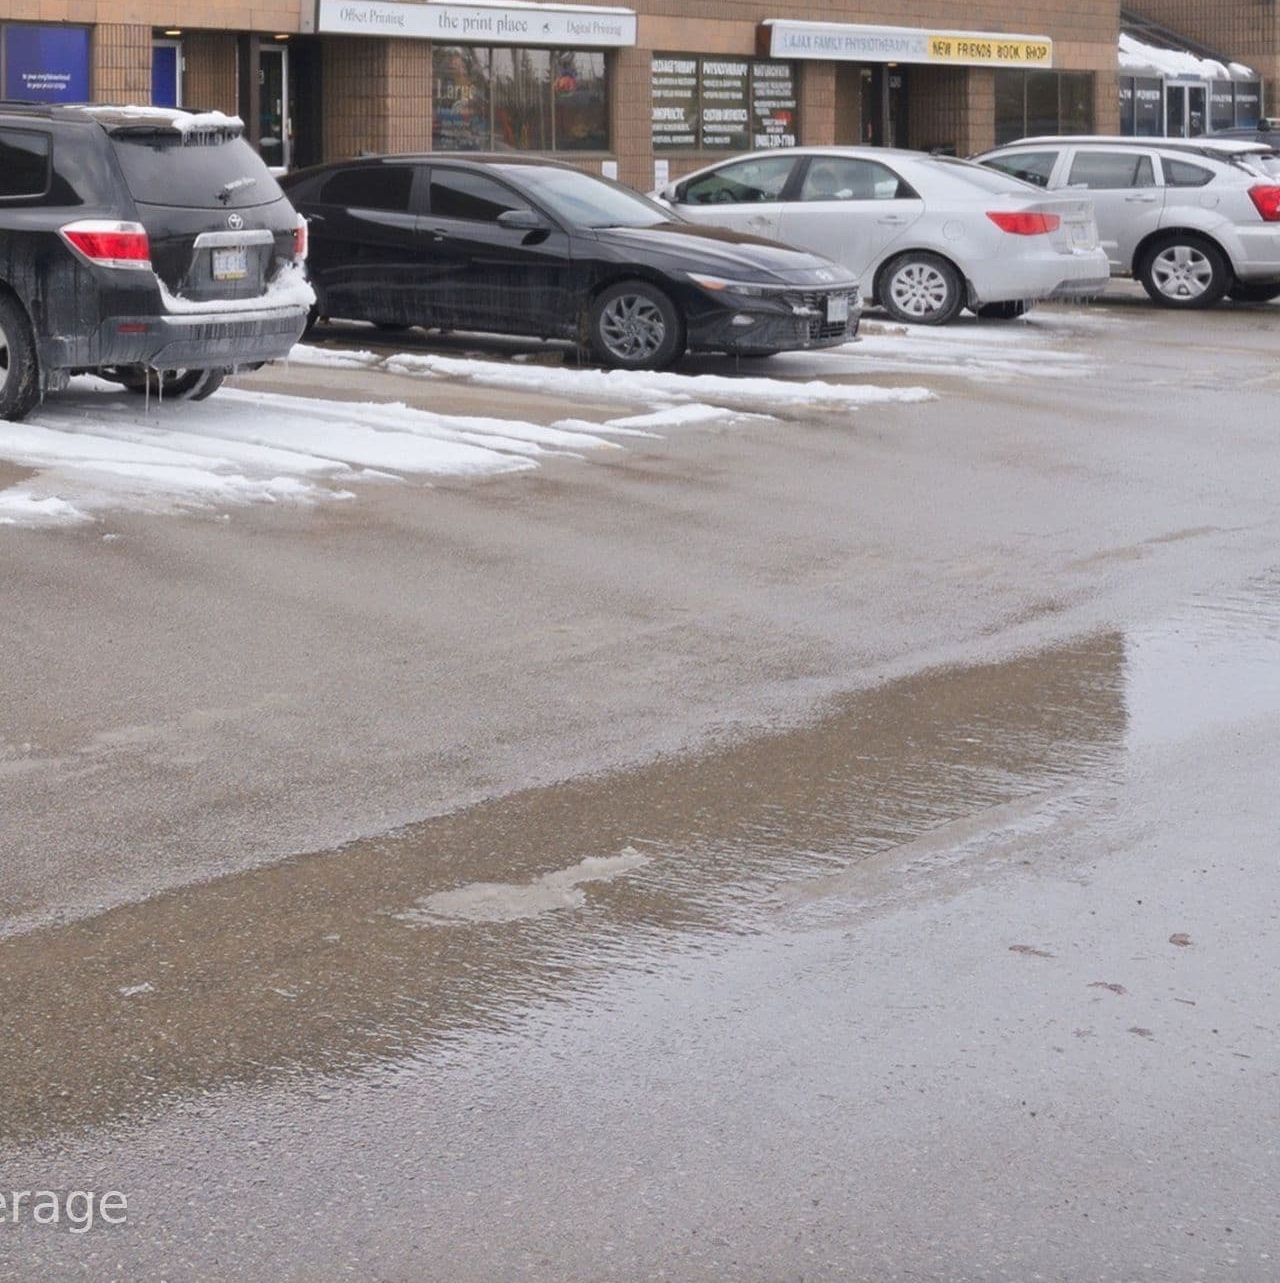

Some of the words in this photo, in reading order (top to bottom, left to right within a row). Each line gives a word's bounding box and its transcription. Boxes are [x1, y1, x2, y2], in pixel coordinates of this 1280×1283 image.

[340, 7, 367, 23] Offset
[369, 8, 405, 27] Printing
[438, 12, 458, 29] the
[462, 12, 492, 33] print
[496, 14, 528, 35] place
[566, 20, 590, 35] Digital
[814, 35, 843, 50] FAMILY
[932, 41, 952, 56] NEW
[957, 43, 991, 58] FRIENDS
[997, 45, 1021, 59] BOOK
[1025, 45, 1048, 60] SHOP
